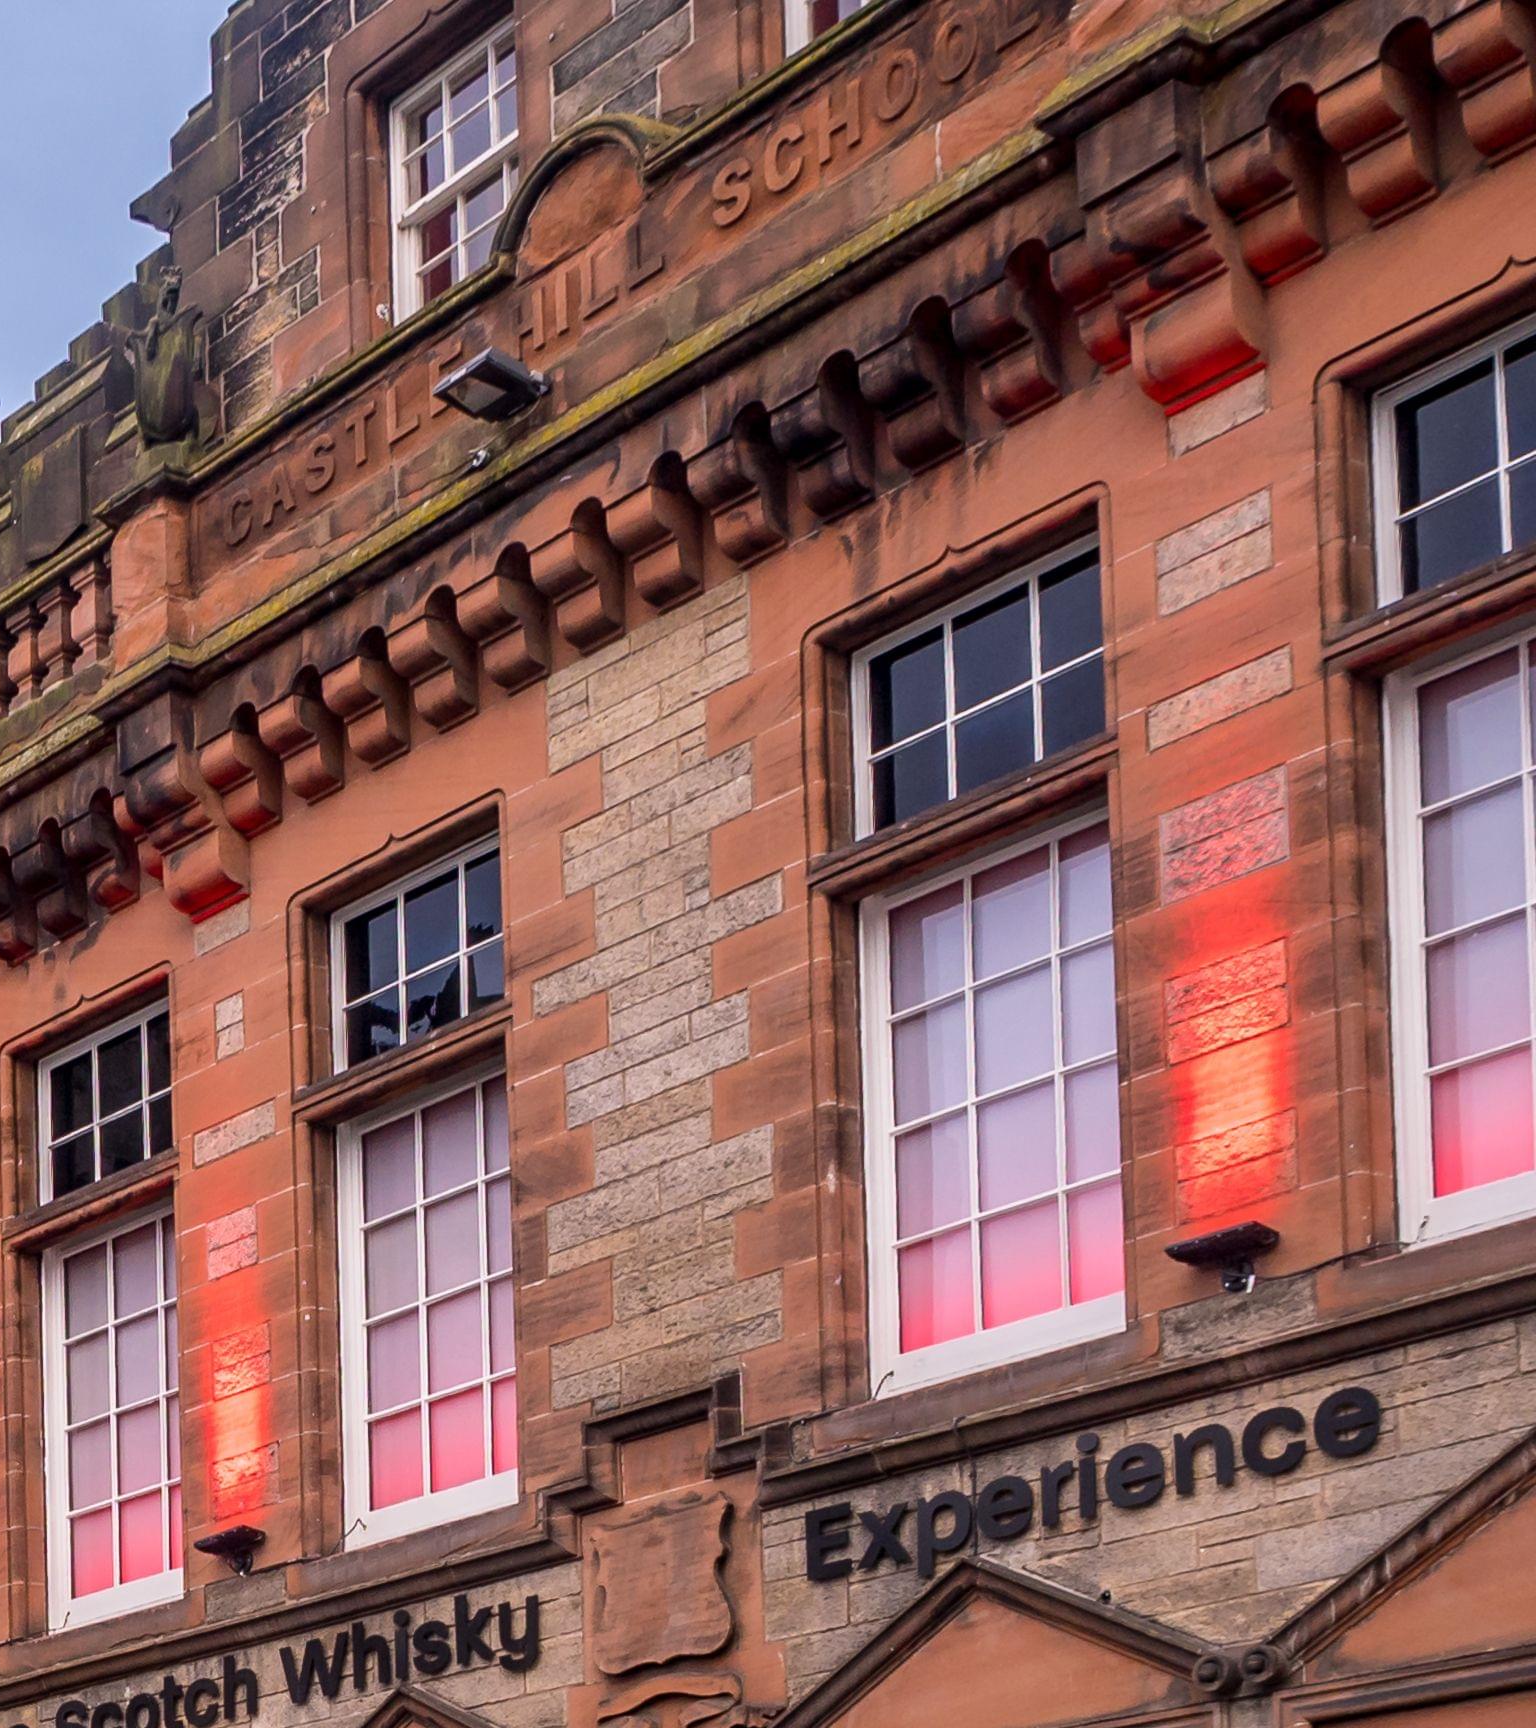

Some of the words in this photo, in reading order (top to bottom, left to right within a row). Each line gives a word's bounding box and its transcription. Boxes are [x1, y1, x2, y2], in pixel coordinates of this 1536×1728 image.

[511, 222, 666, 362] HILL
[711, 0, 1042, 227] SCHOOL
[279, 1593, 541, 1703] Whisky
[804, 1386, 1382, 1582] Experience
